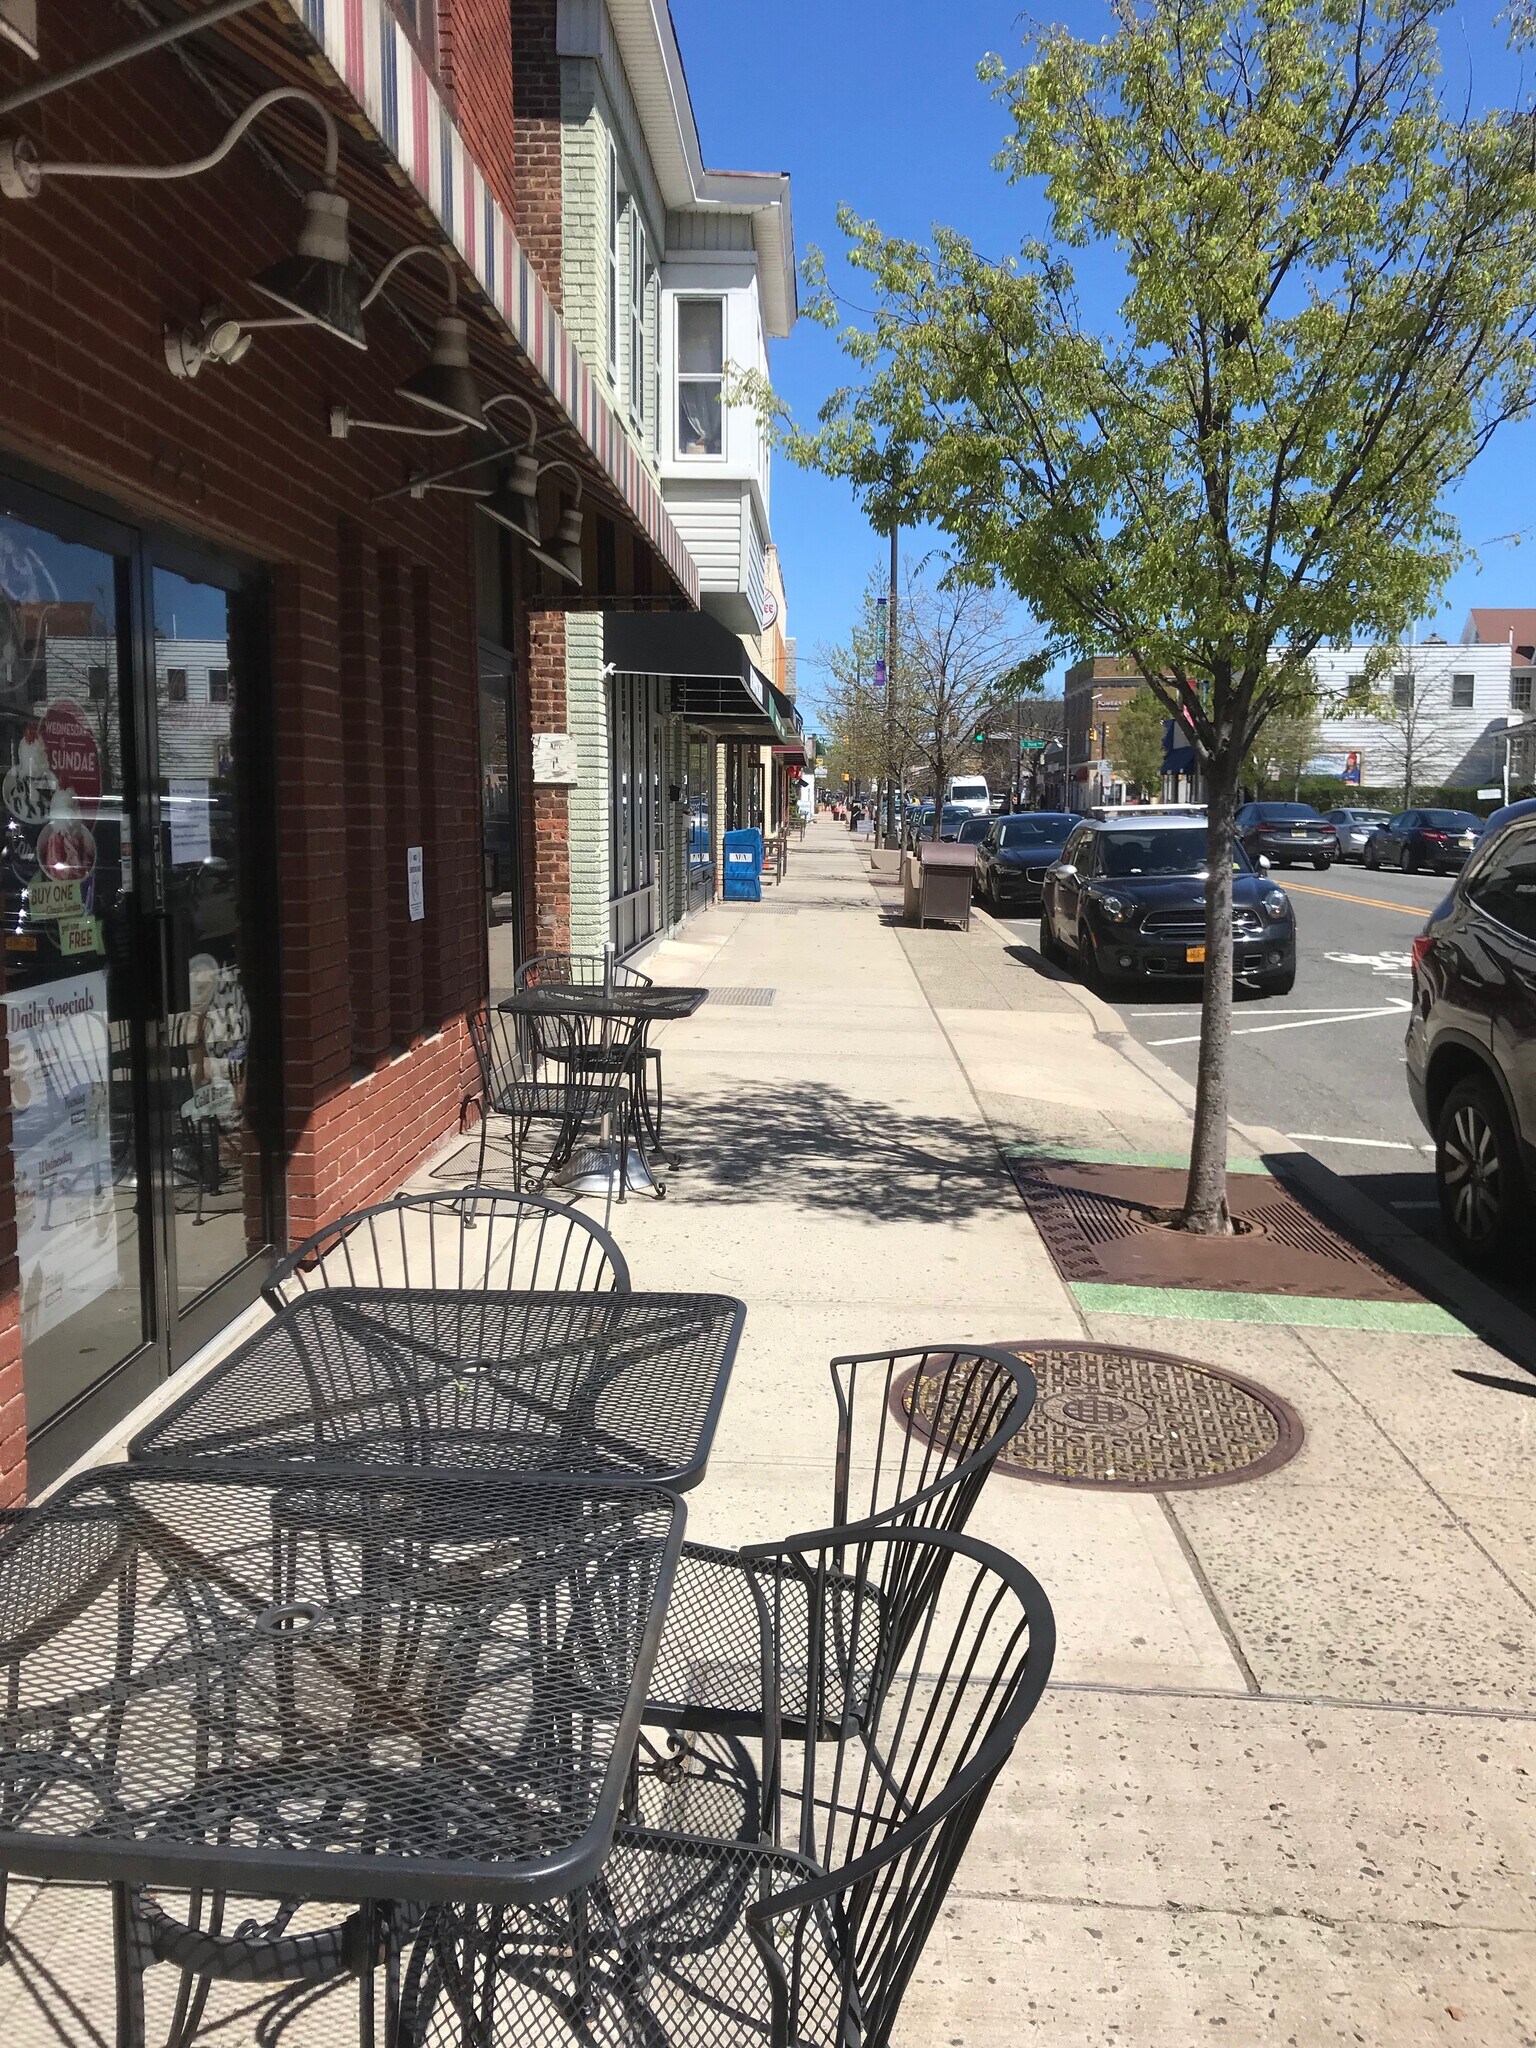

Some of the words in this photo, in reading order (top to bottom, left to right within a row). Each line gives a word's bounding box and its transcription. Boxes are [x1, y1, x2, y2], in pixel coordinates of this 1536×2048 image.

[51, 749, 96, 772] SUNDAE
[31, 886, 51, 905] BUY
[53, 884, 73, 902] ONE
[69, 928, 93, 948] FREE
[11, 1001, 45, 1033] Daily
[47, 987, 94, 1022] Specials
